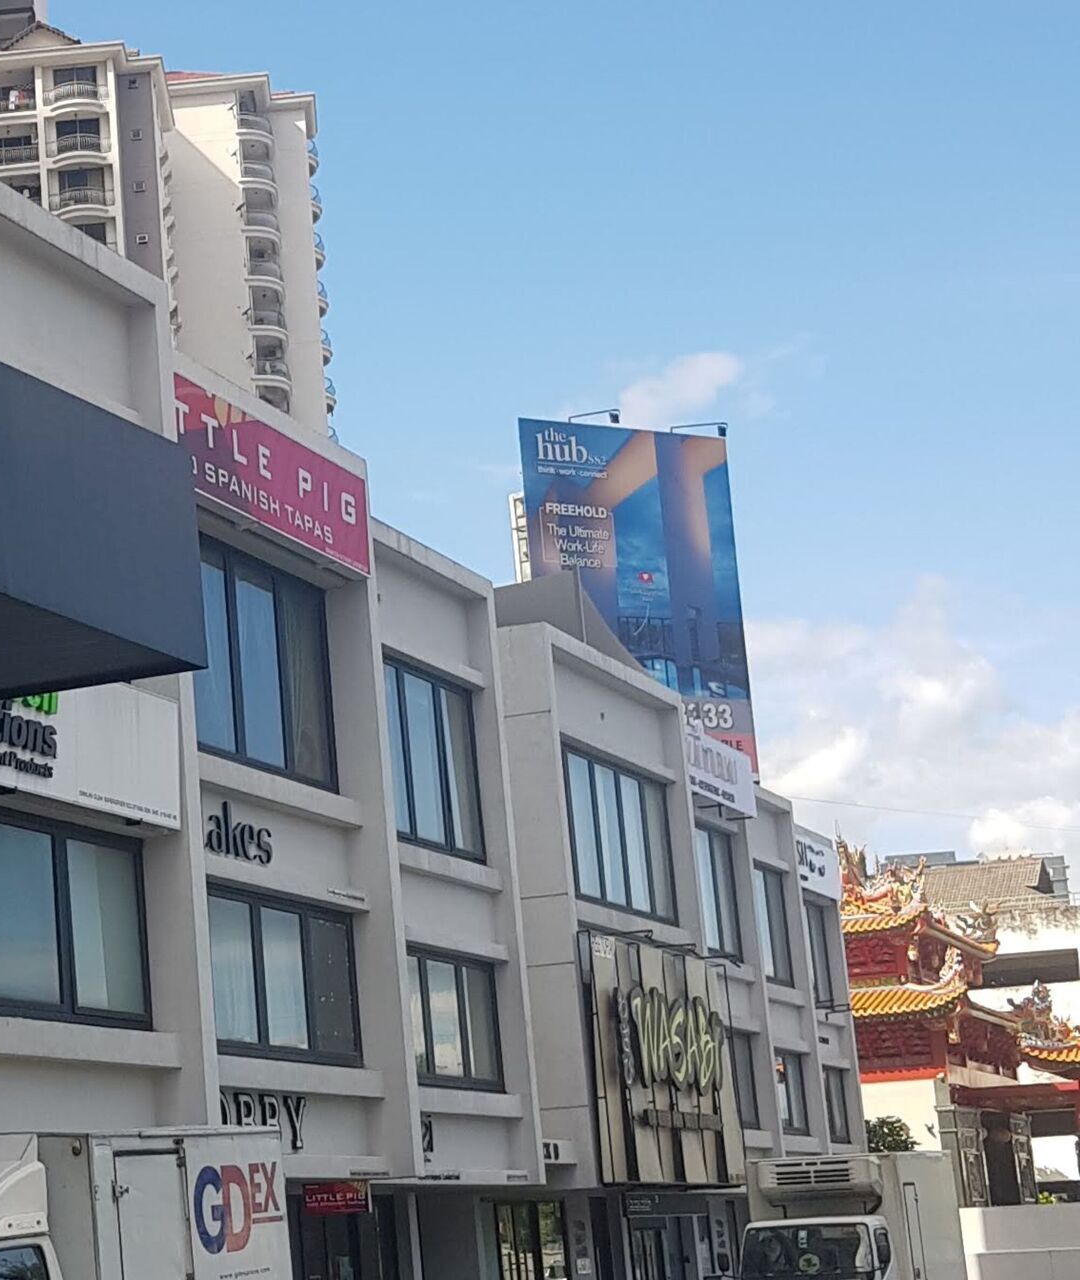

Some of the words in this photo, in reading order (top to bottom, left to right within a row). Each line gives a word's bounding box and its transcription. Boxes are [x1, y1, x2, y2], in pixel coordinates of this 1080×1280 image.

[535, 432, 589, 464] hub
[543, 427, 568, 443] the
[204, 462, 281, 518] SPANISH
[284, 504, 334, 545] TAPAS
[298, 467, 357, 525] PIG
[545, 502, 608, 519] FREEHOLD
[547, 522, 567, 537] The
[569, 524, 610, 541] Ultimate
[560, 554, 602, 569] Balance
[8, 749, 54, 779] Products
[205, 800, 273, 865] akes
[193, 1160, 281, 1255] GDEX
